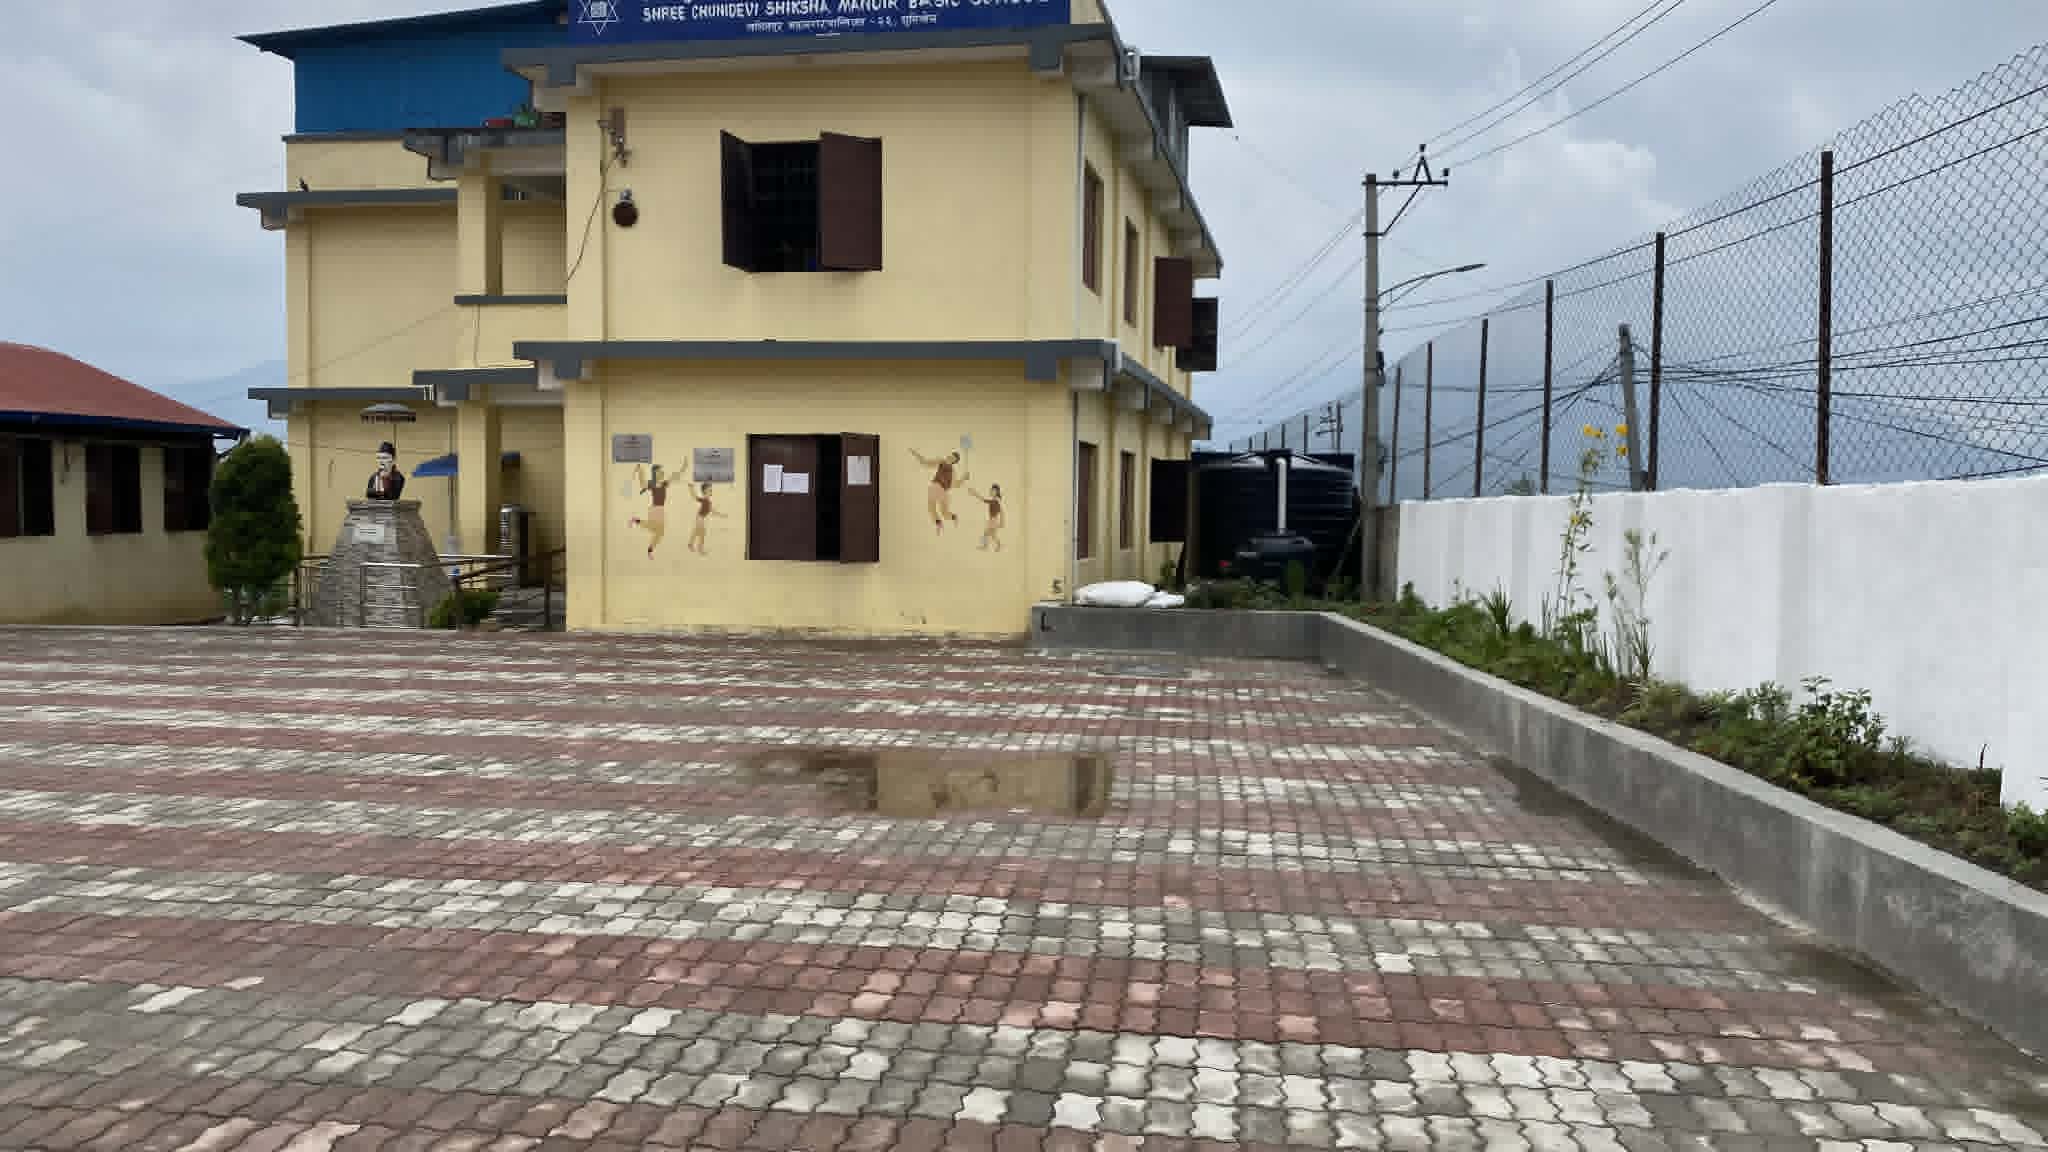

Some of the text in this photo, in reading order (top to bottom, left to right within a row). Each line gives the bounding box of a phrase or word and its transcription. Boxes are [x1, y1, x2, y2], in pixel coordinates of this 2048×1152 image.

[643, 6, 686, 22] SHREE
[692, 3, 759, 18] CHUNIDEVI
[767, 0, 829, 15] SHIKSHA
